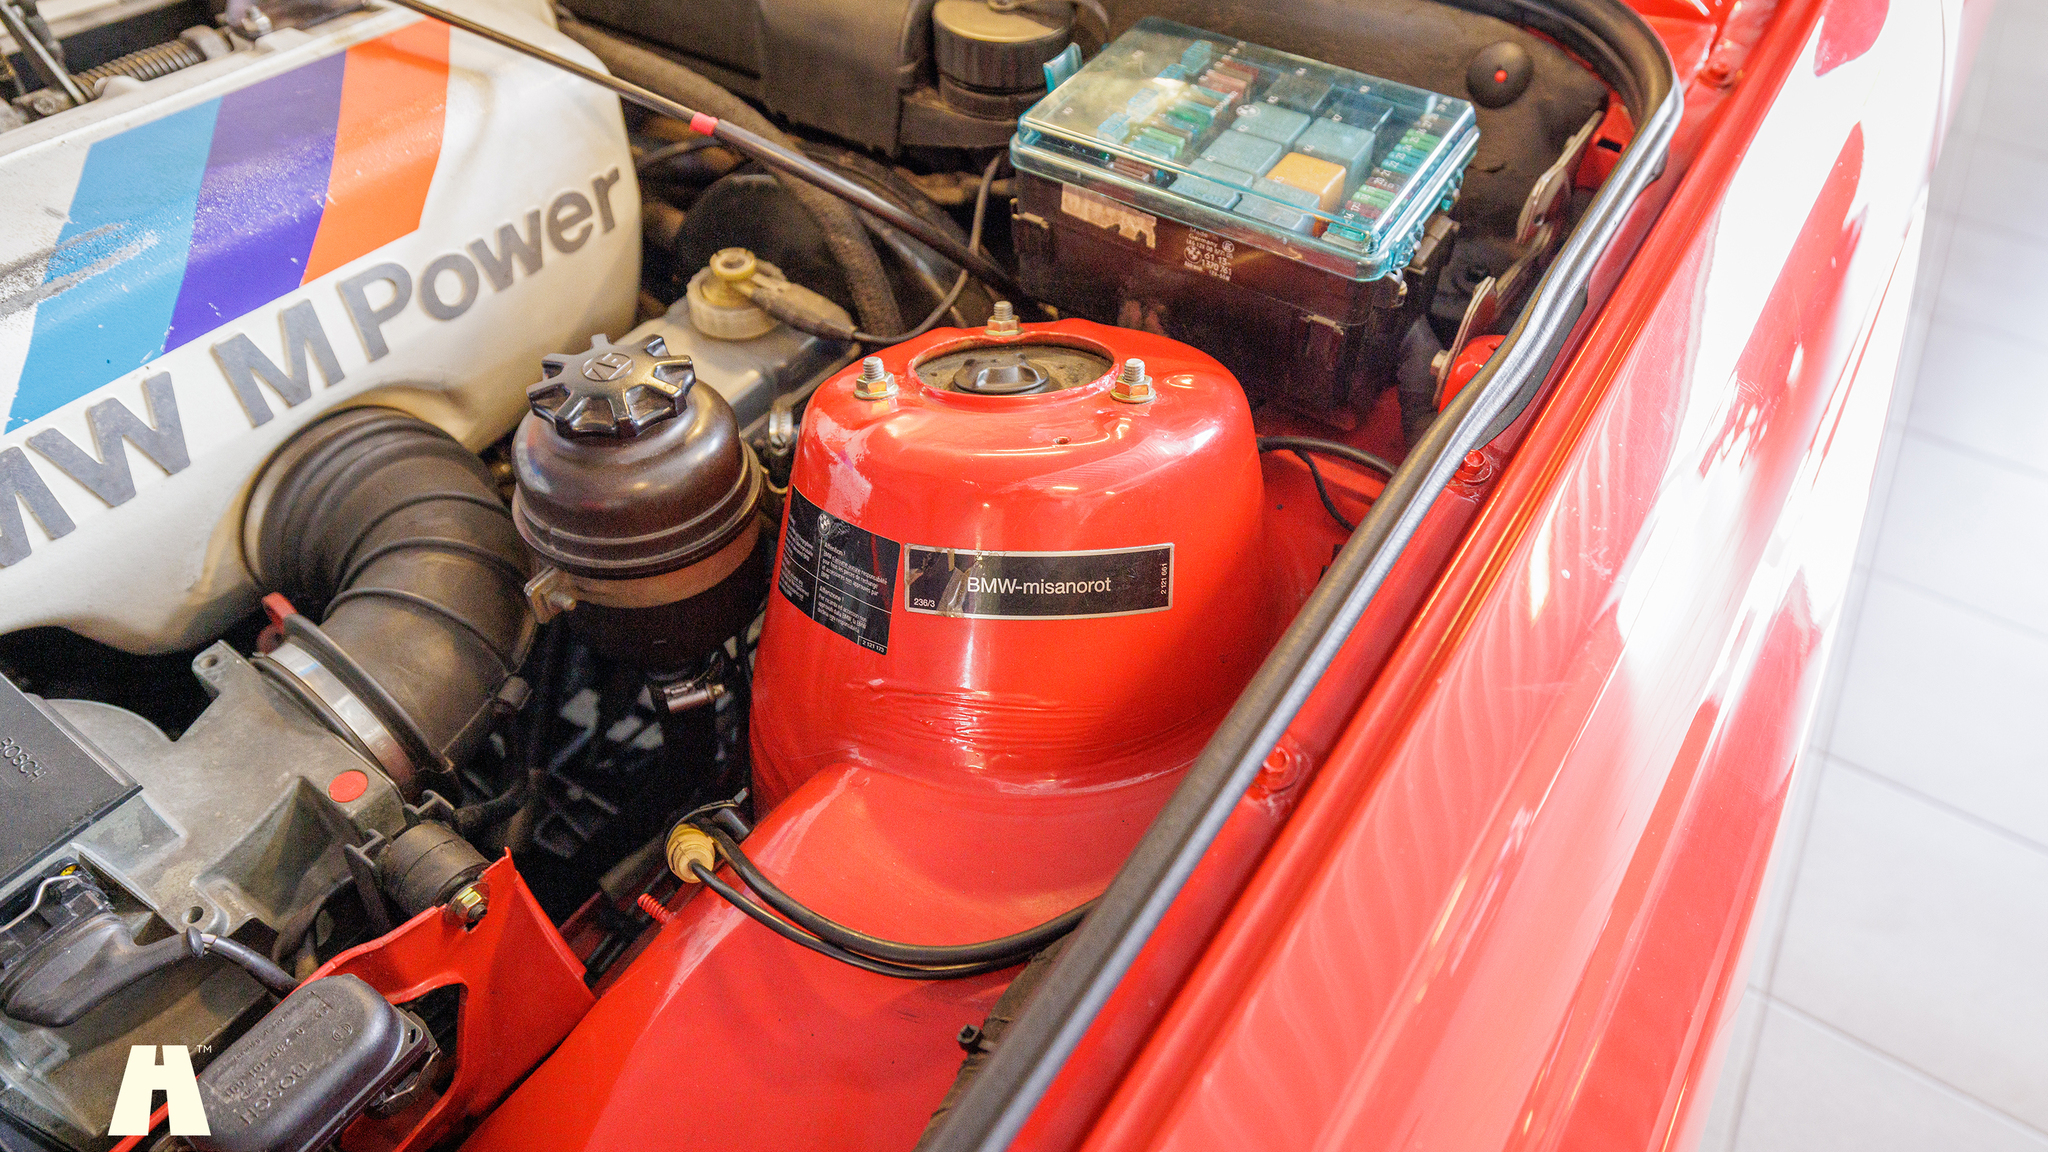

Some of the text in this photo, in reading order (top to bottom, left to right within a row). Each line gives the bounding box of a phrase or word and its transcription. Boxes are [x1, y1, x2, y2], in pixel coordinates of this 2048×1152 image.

[337, 166, 622, 363] Power
[967, 576, 1111, 594] BMW-misanorot
[240, 1061, 312, 1125] BOSCH
